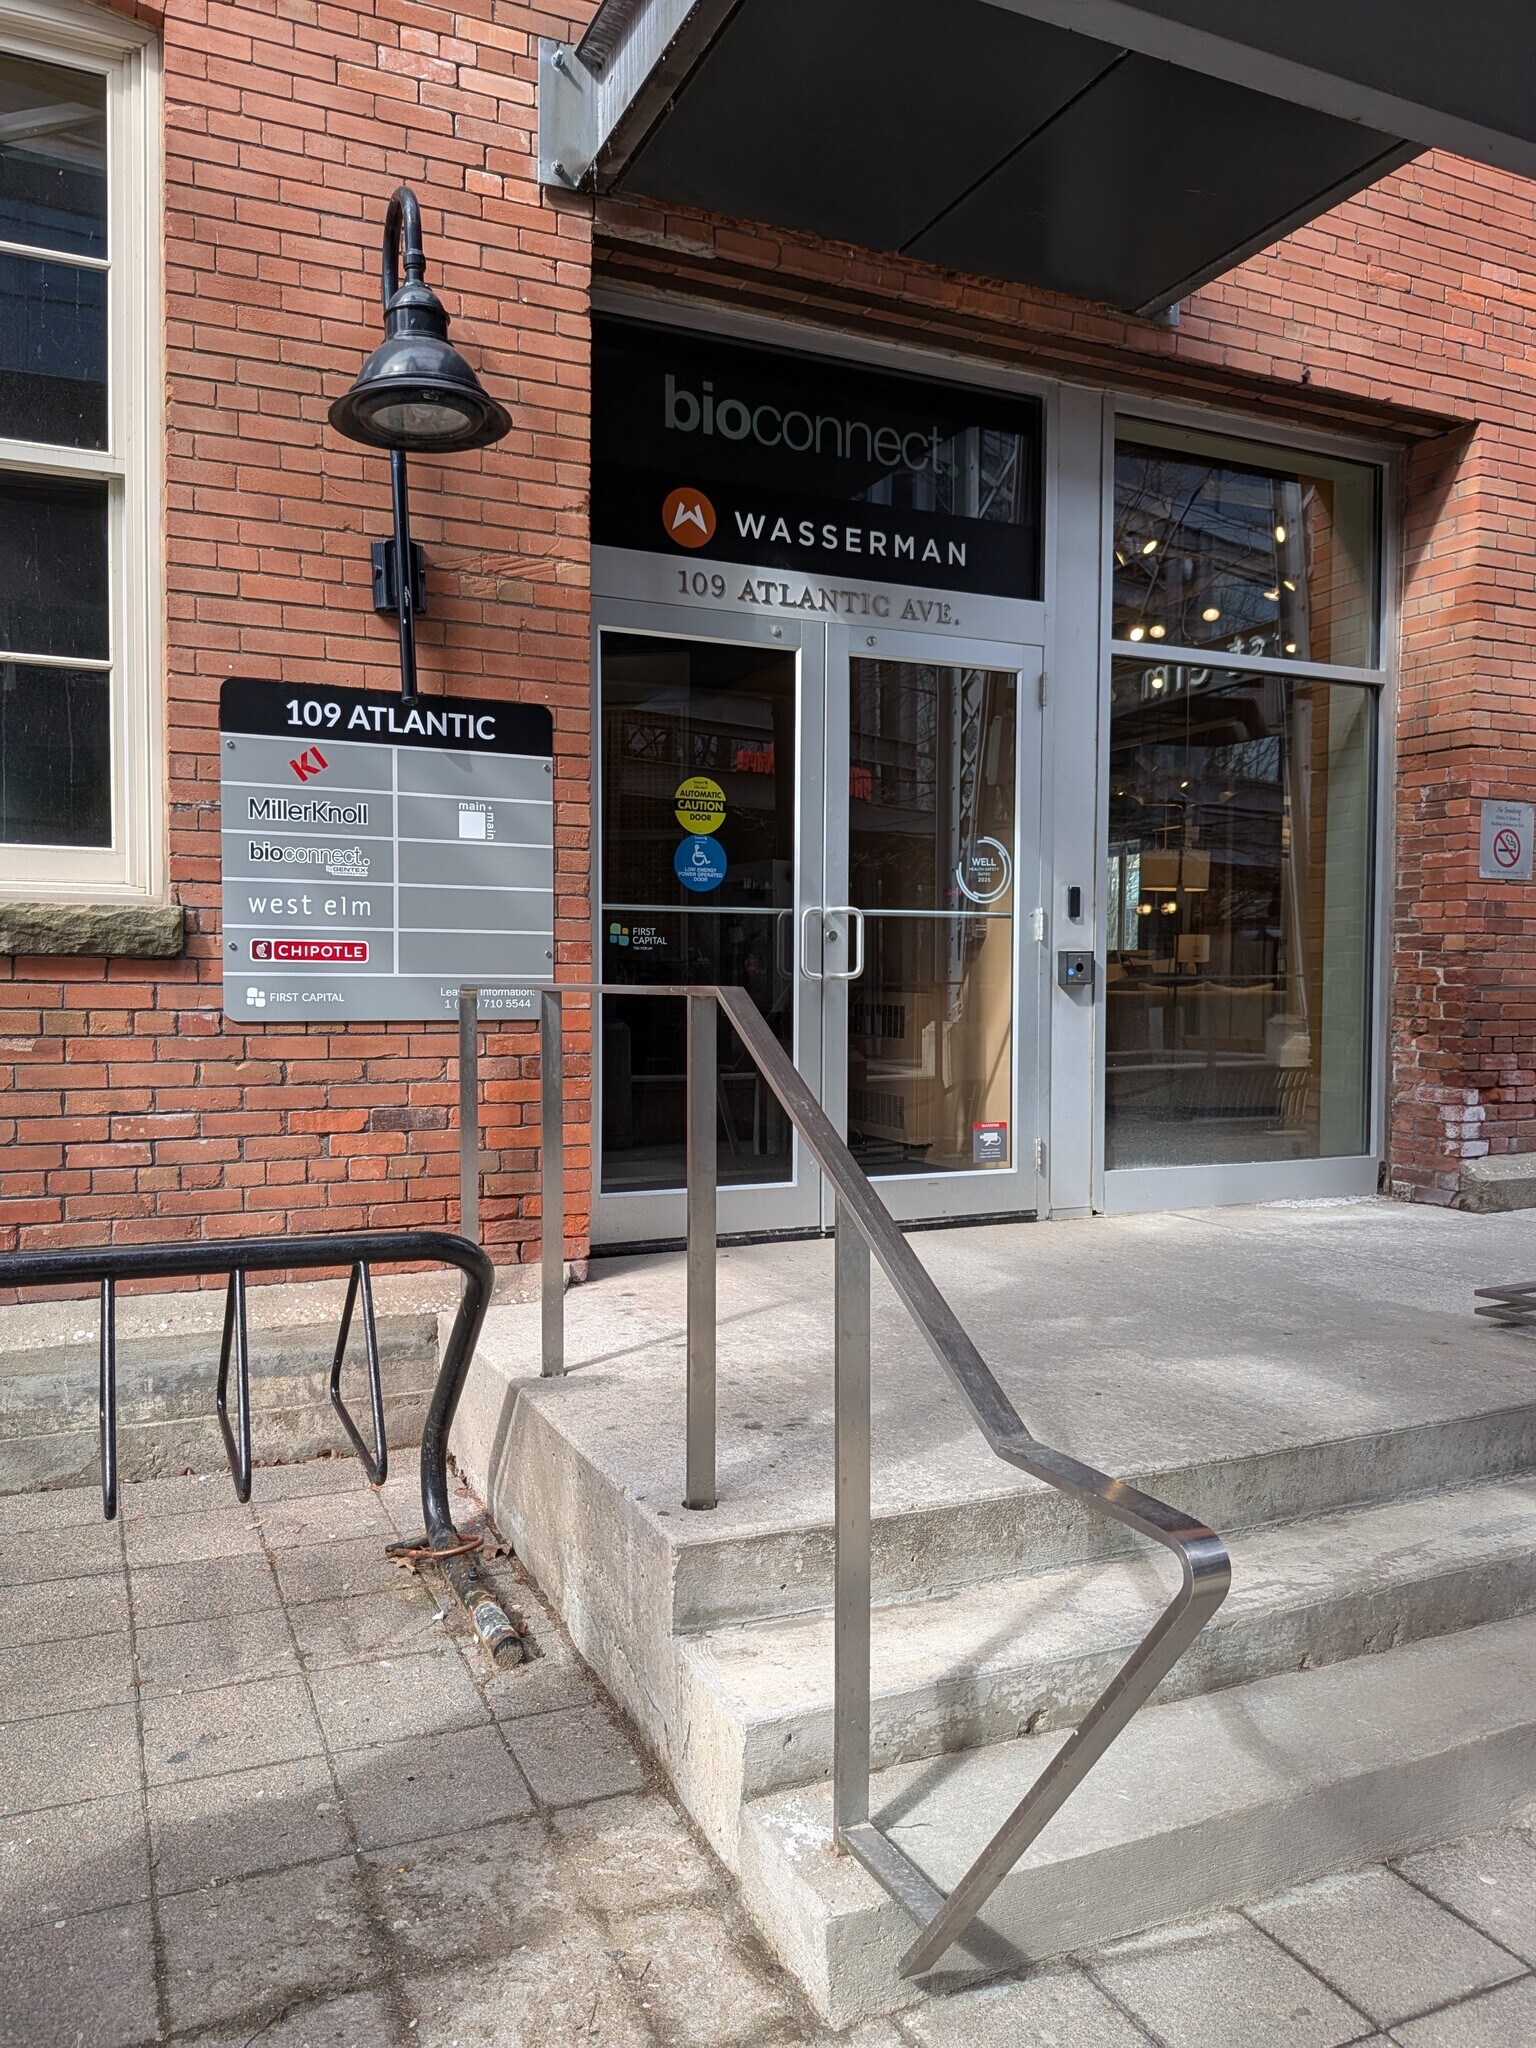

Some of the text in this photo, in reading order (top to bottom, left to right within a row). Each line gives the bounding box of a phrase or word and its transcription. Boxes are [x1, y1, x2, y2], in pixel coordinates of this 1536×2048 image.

[734, 510, 967, 567] WASSERMAN
[677, 569, 961, 626] 109 ATLANTIC AVE.
[286, 699, 496, 741] 109 ATLANTIC
[289, 746, 329, 782] KI
[679, 789, 722, 799] AUTOMATIC
[247, 797, 369, 826] MillerKnoll
[677, 800, 724, 812] CAUTION
[690, 813, 712, 822] DOOR
[486, 812, 496, 840] main
[971, 857, 997, 867] WELL
[248, 893, 372, 917] west elm
[632, 927, 656, 936] FIRST
[632, 936, 668, 945] CAPITAL
[277, 943, 364, 959] CHIPOTLE
[269, 992, 345, 1002] FIRST CAPITAL
[444, 999, 452, 1009] 1
[483, 998, 503, 1009] 710
[505, 998, 532, 1009] 5544
